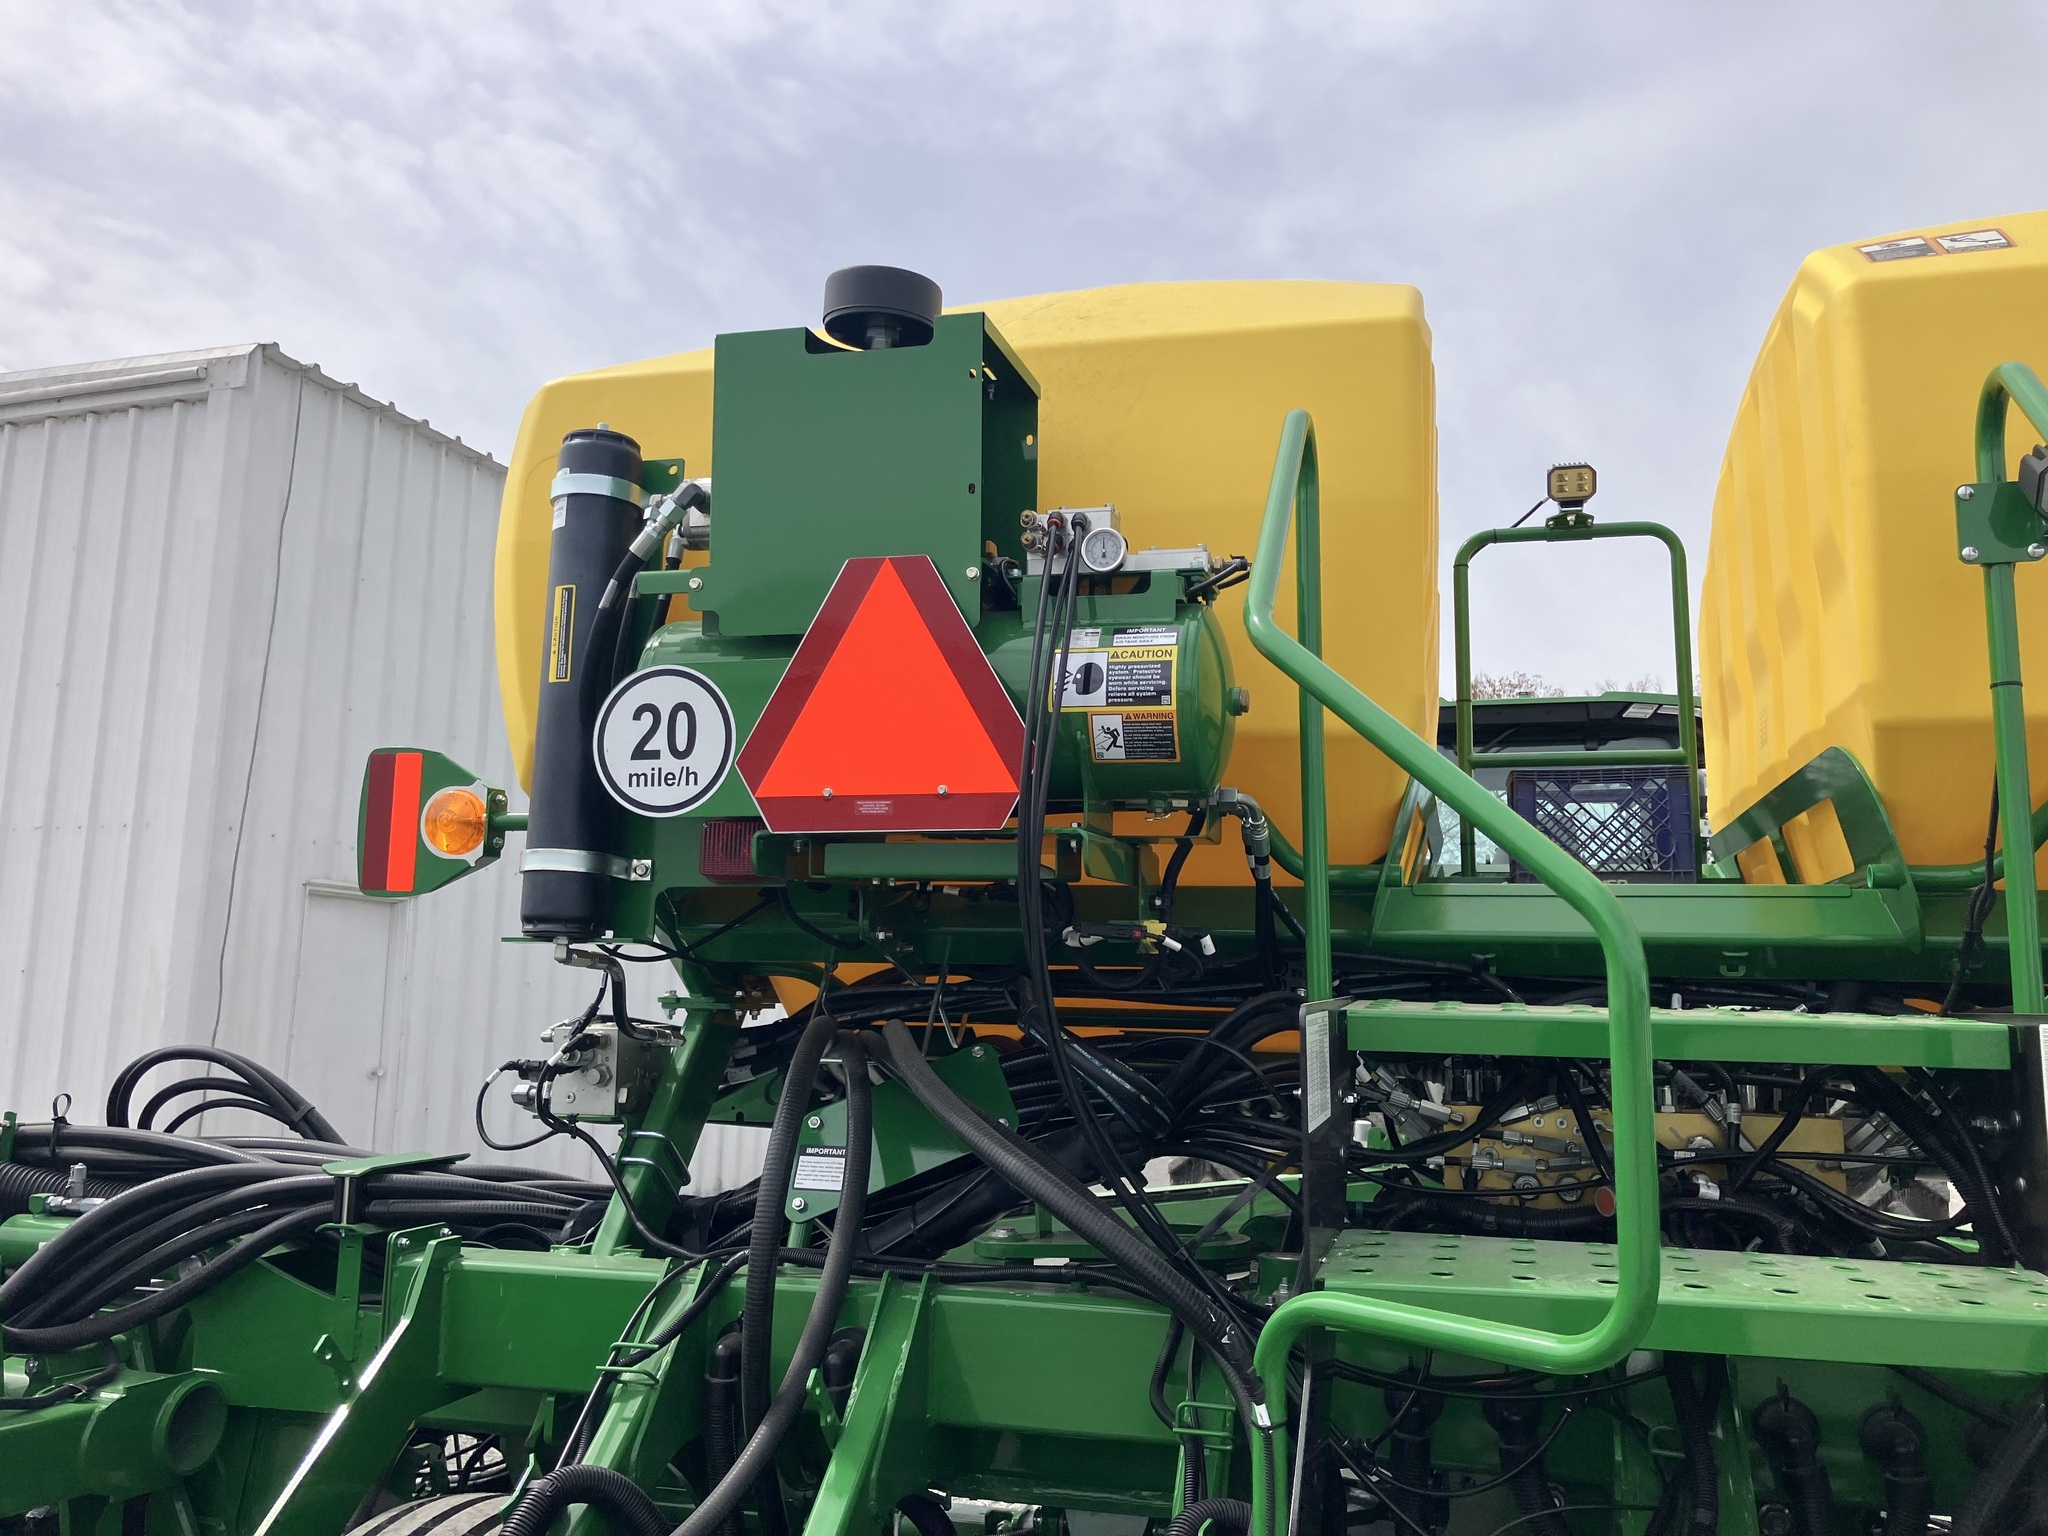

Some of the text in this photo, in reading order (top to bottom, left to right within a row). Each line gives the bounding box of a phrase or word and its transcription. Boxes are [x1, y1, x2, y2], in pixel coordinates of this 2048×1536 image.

[1120, 649, 1173, 659] CAUTION
[1132, 712, 1174, 720] WARNING
[630, 702, 697, 761] 20
[628, 766, 698, 788] mile/h
[806, 1148, 846, 1156] IMPORTANT
